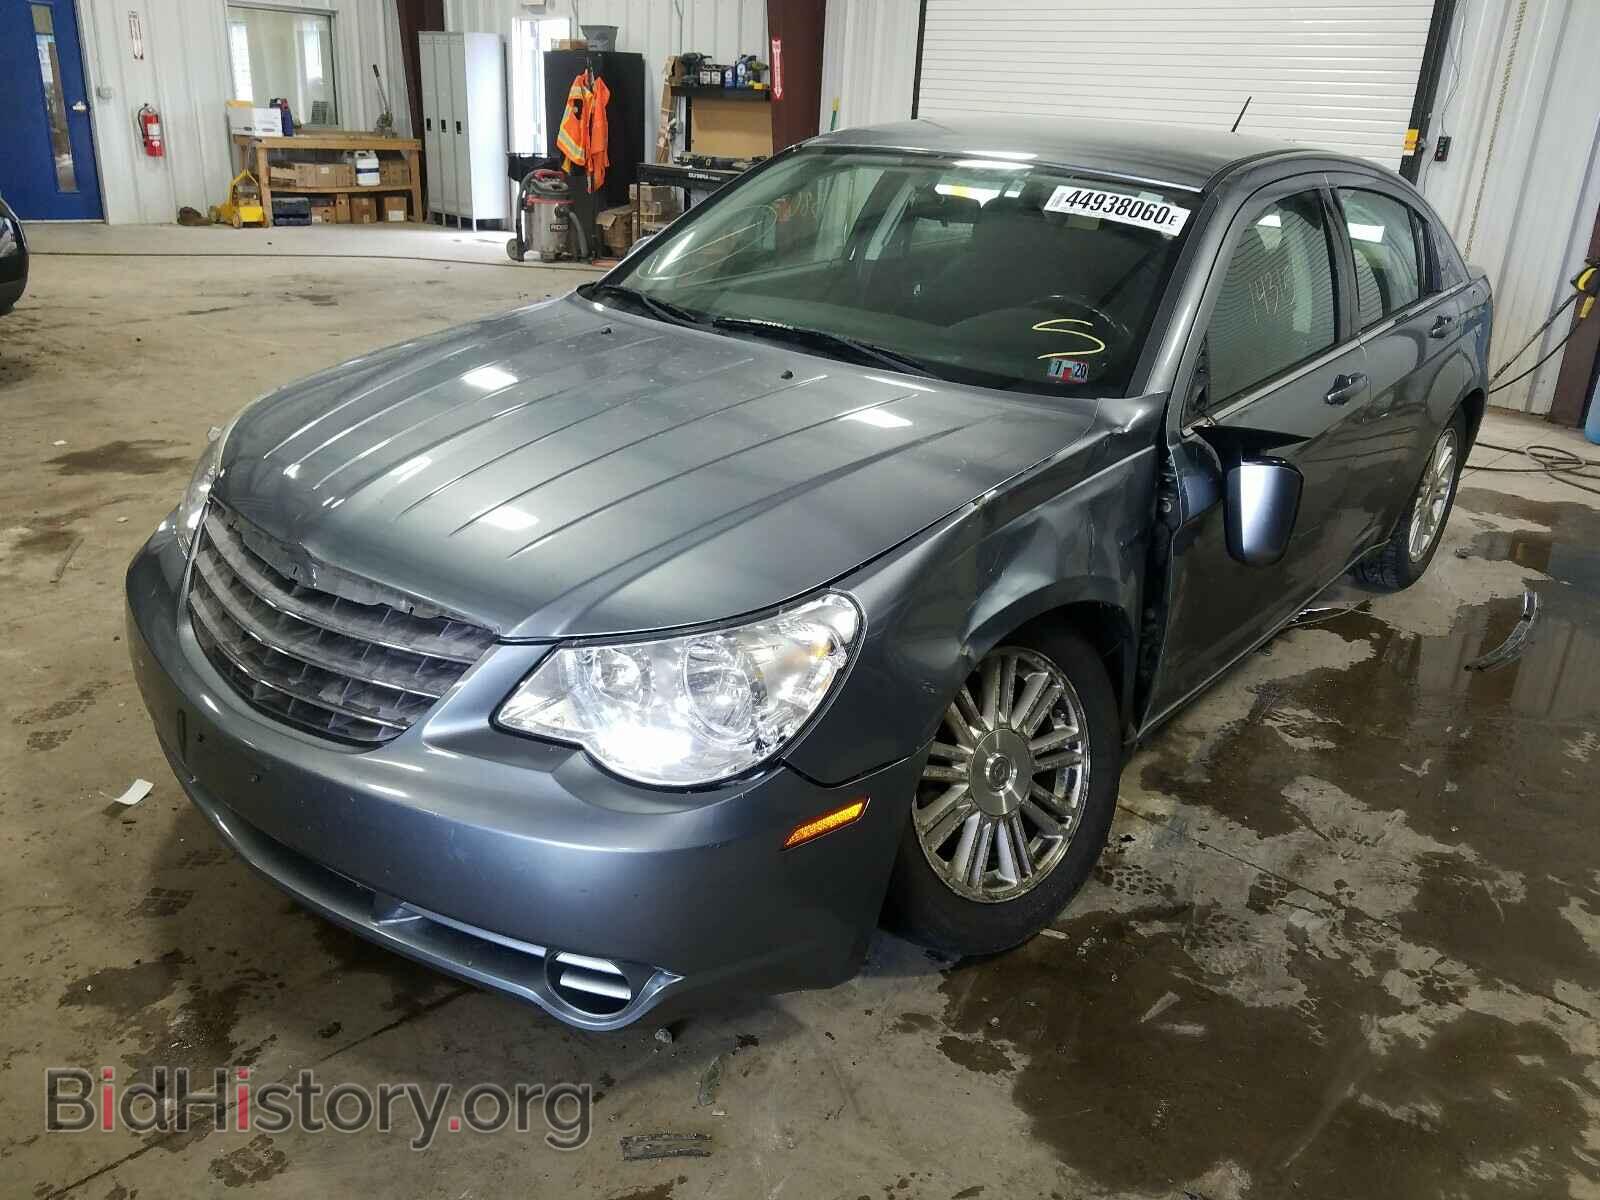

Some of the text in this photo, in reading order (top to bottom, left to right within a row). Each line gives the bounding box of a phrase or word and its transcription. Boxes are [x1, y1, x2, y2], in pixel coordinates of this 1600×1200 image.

[1065, 190, 1171, 225] 44938060
[1168, 215, 1180, 227] E
[1074, 363, 1087, 379] 20
